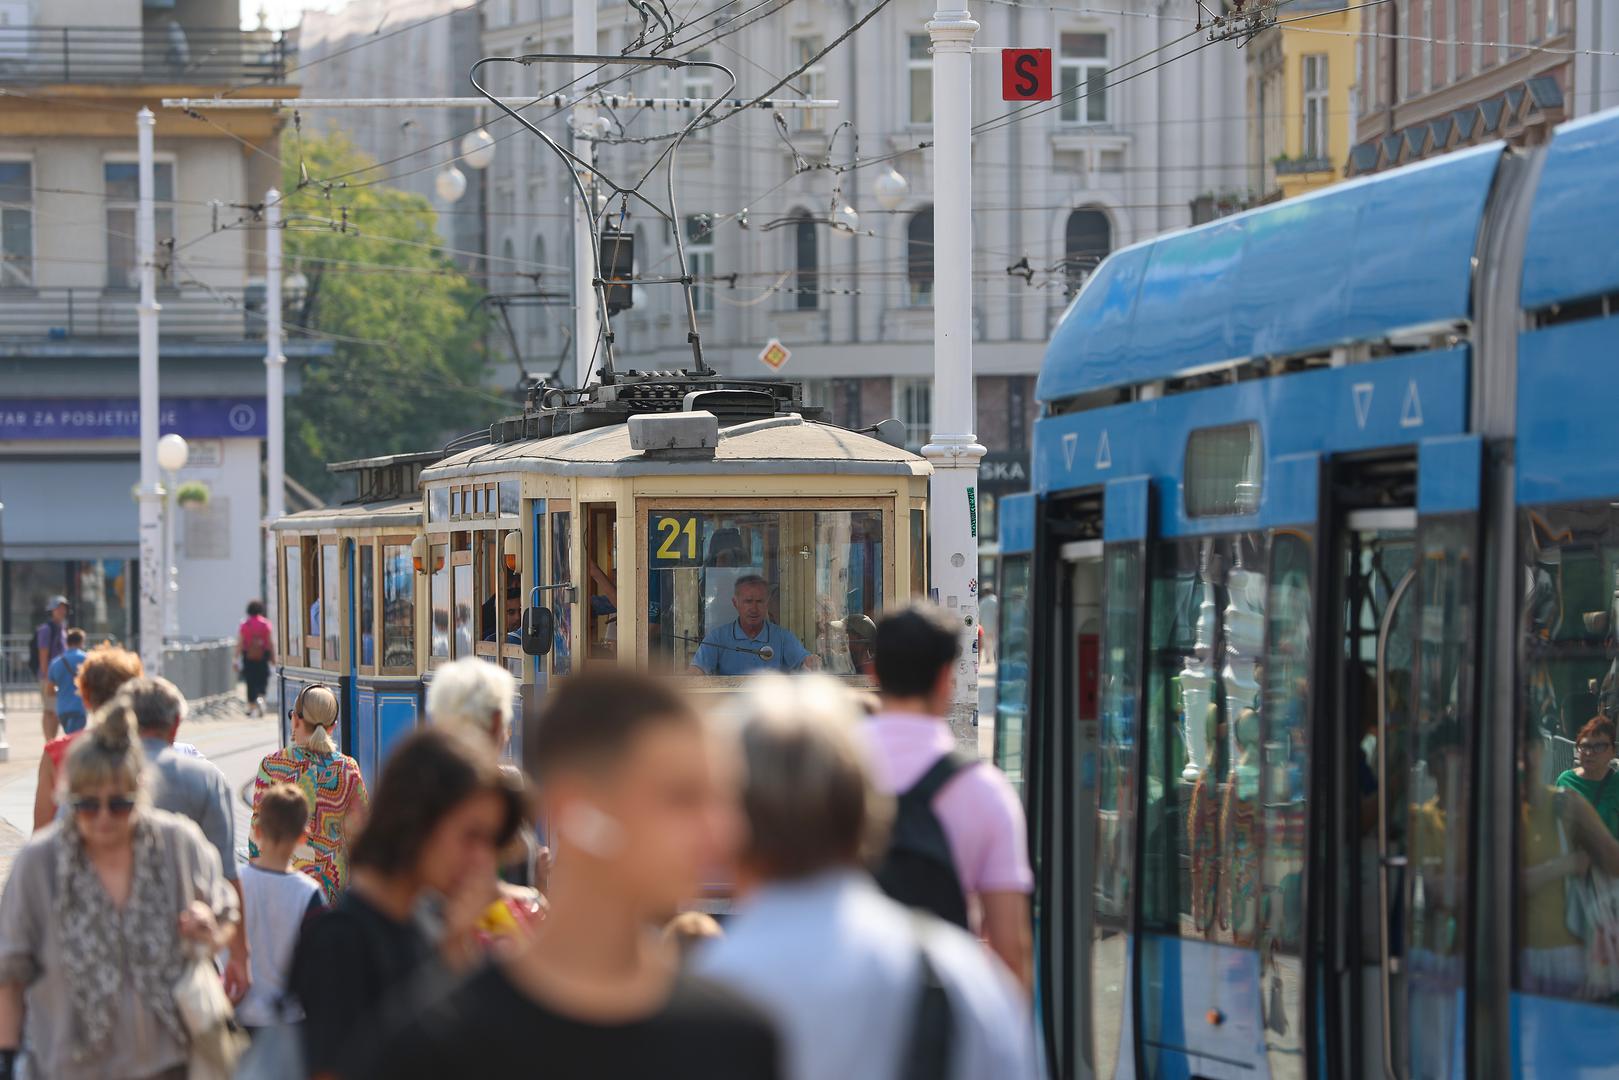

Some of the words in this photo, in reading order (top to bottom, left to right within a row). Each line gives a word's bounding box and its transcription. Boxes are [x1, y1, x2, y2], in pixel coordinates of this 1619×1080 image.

[1015, 54, 1039, 96] S
[33, 411, 55, 426] ZA
[656, 517, 696, 559] 21
